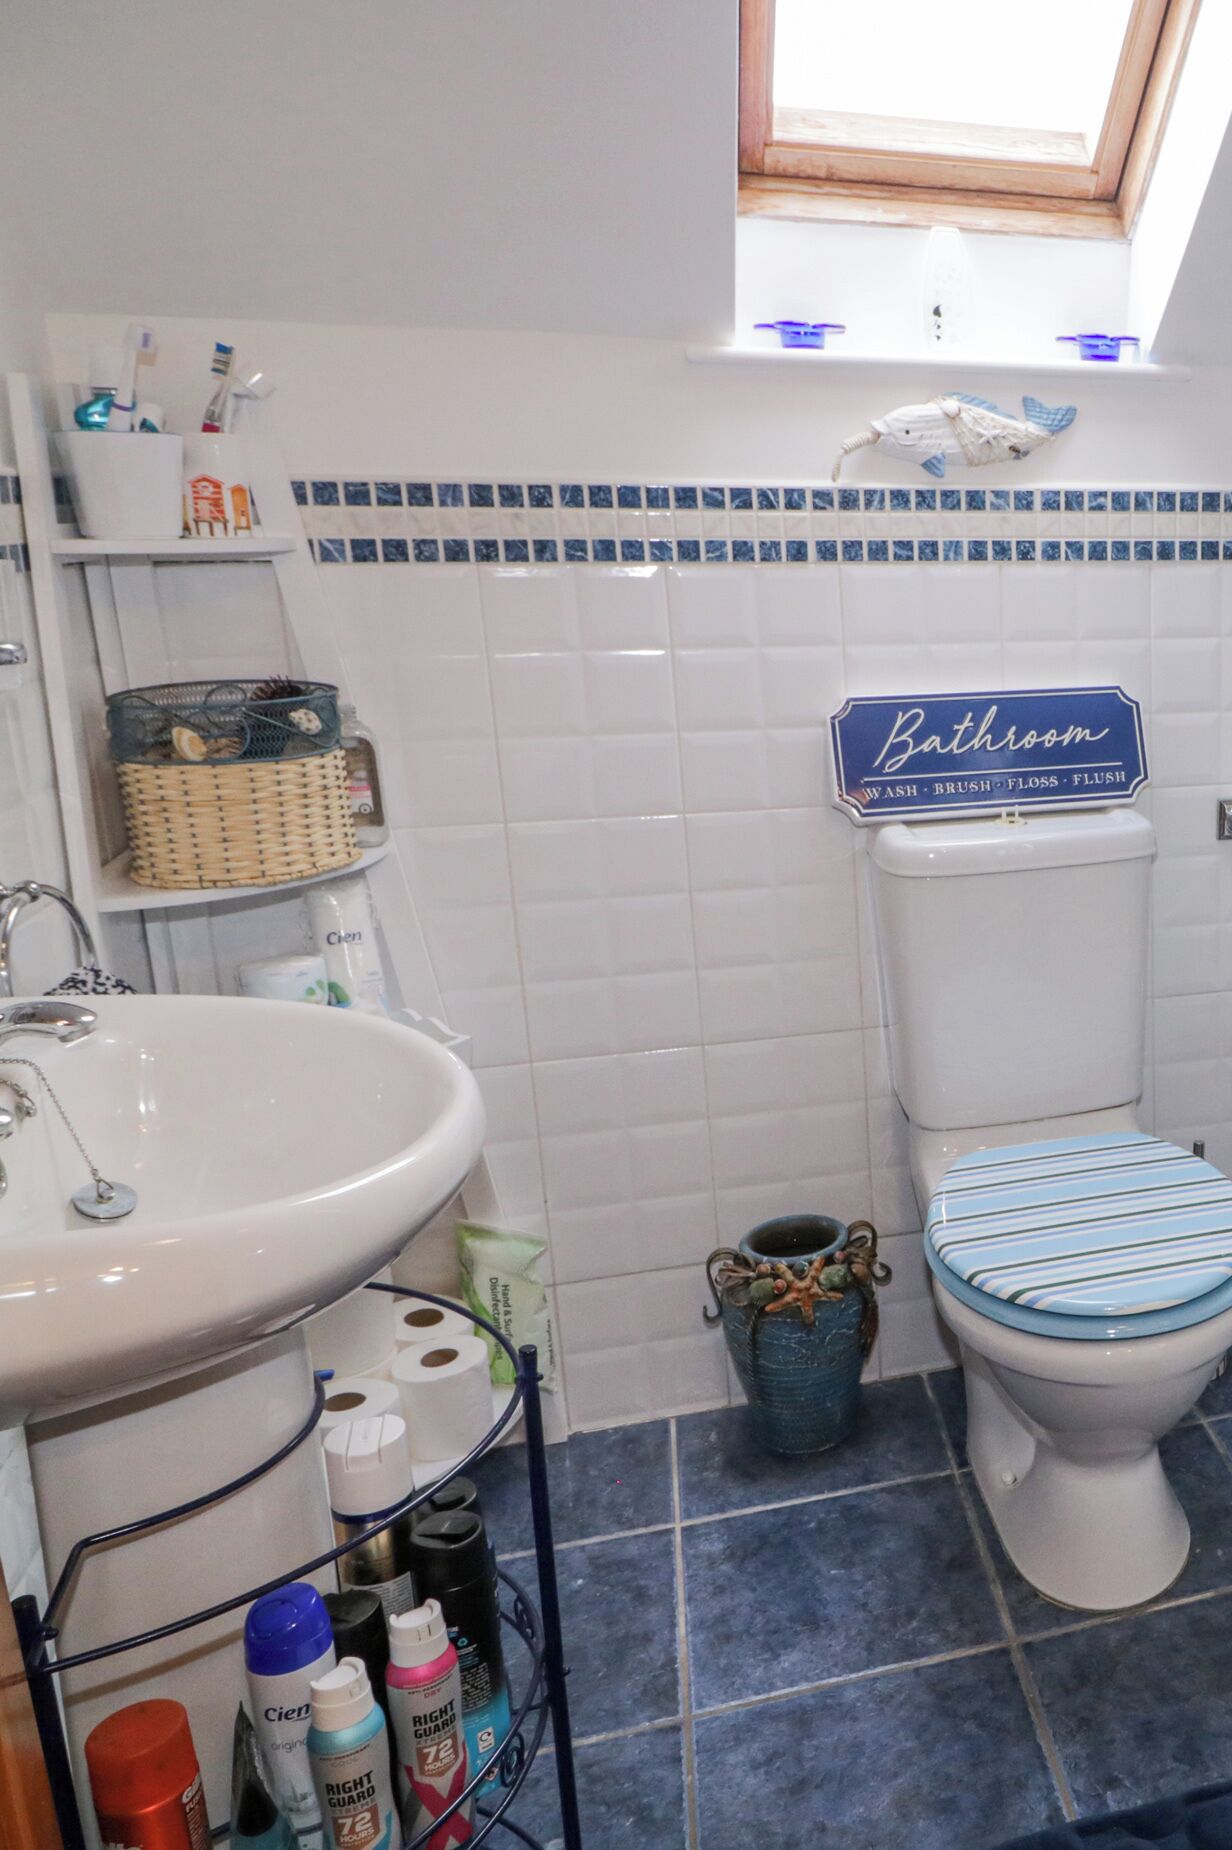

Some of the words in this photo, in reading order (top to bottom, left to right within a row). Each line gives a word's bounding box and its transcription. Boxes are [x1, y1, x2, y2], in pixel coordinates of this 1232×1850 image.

[872, 705, 1110, 774] Bathroom
[864, 784, 918, 800] WASH
[932, 780, 992, 796] BRUSH
[1007, 775, 1059, 790] FLOSS
[1073, 771, 1126, 786] FLUSH
[326, 931, 362, 946] Cien
[501, 1284, 512, 1308] Hand
[503, 1309, 512, 1317] &
[264, 1703, 311, 1722] Cien
[412, 1698, 455, 1728] RIGHT
[414, 1713, 456, 1739] GUARD
[423, 1738, 453, 1764] 72
[424, 1753, 456, 1772] HOURS
[325, 1770, 373, 1796] RIGHT
[328, 1785, 376, 1808] GUARD
[338, 1811, 373, 1836] 72
[340, 1827, 375, 1843] HOURS
